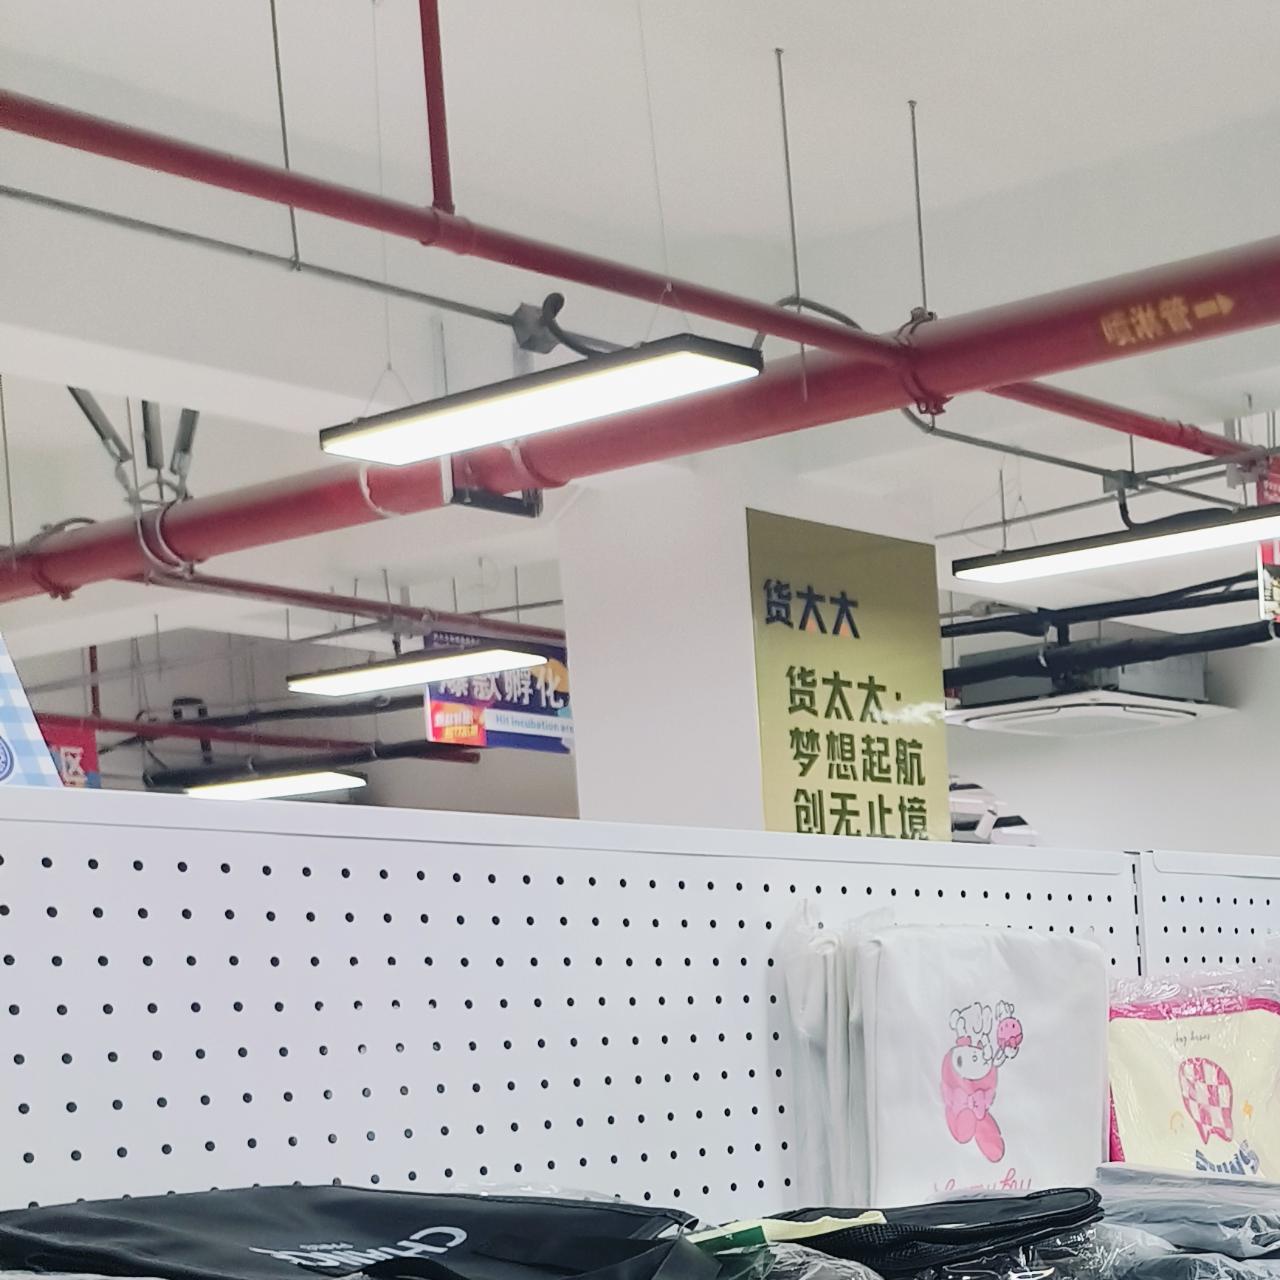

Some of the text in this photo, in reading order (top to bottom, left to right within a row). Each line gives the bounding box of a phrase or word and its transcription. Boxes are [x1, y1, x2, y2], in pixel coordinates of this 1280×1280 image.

[789, 727, 927, 786] 梦想起航
[793, 788, 930, 841] 创无止境
